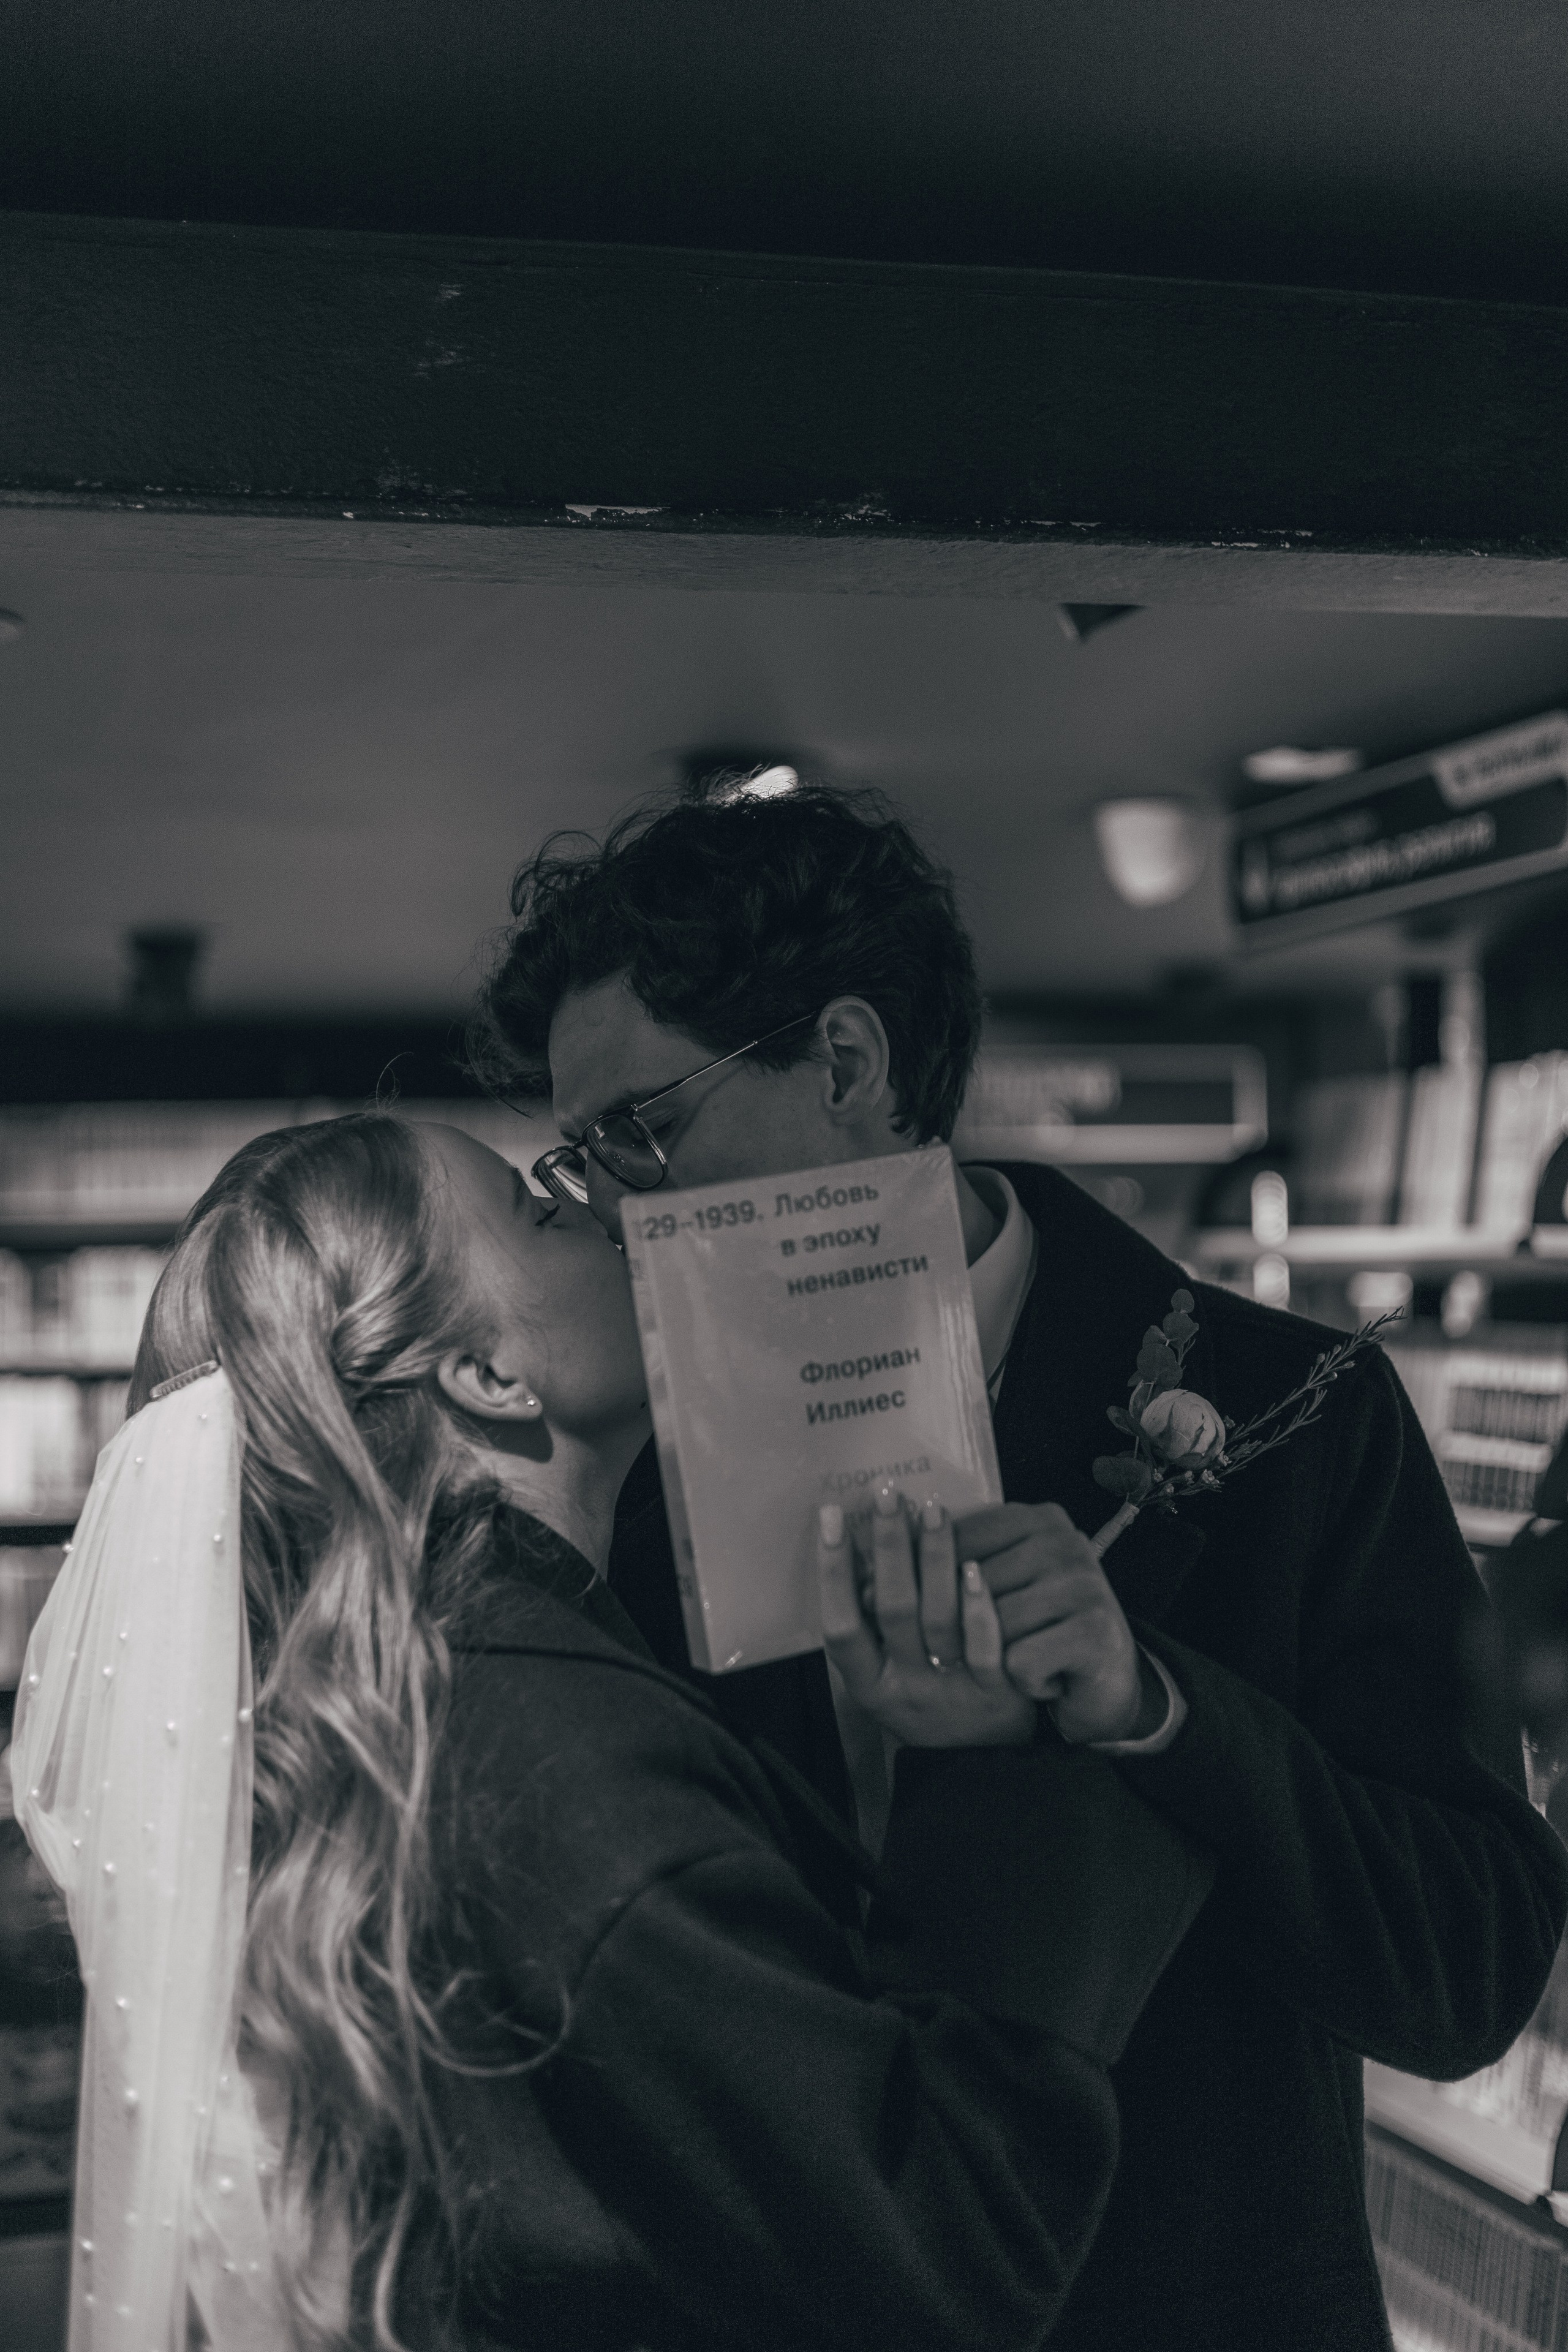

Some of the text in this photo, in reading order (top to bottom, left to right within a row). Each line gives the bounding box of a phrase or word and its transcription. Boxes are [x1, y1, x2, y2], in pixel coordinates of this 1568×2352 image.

[774, 1182, 879, 1217] Любовь
[780, 1222, 881, 1257] в эпоху
[786, 1253, 929, 1297] ненависти
[799, 1346, 921, 1386] Флориан
[805, 1388, 906, 1425] Иллиес
